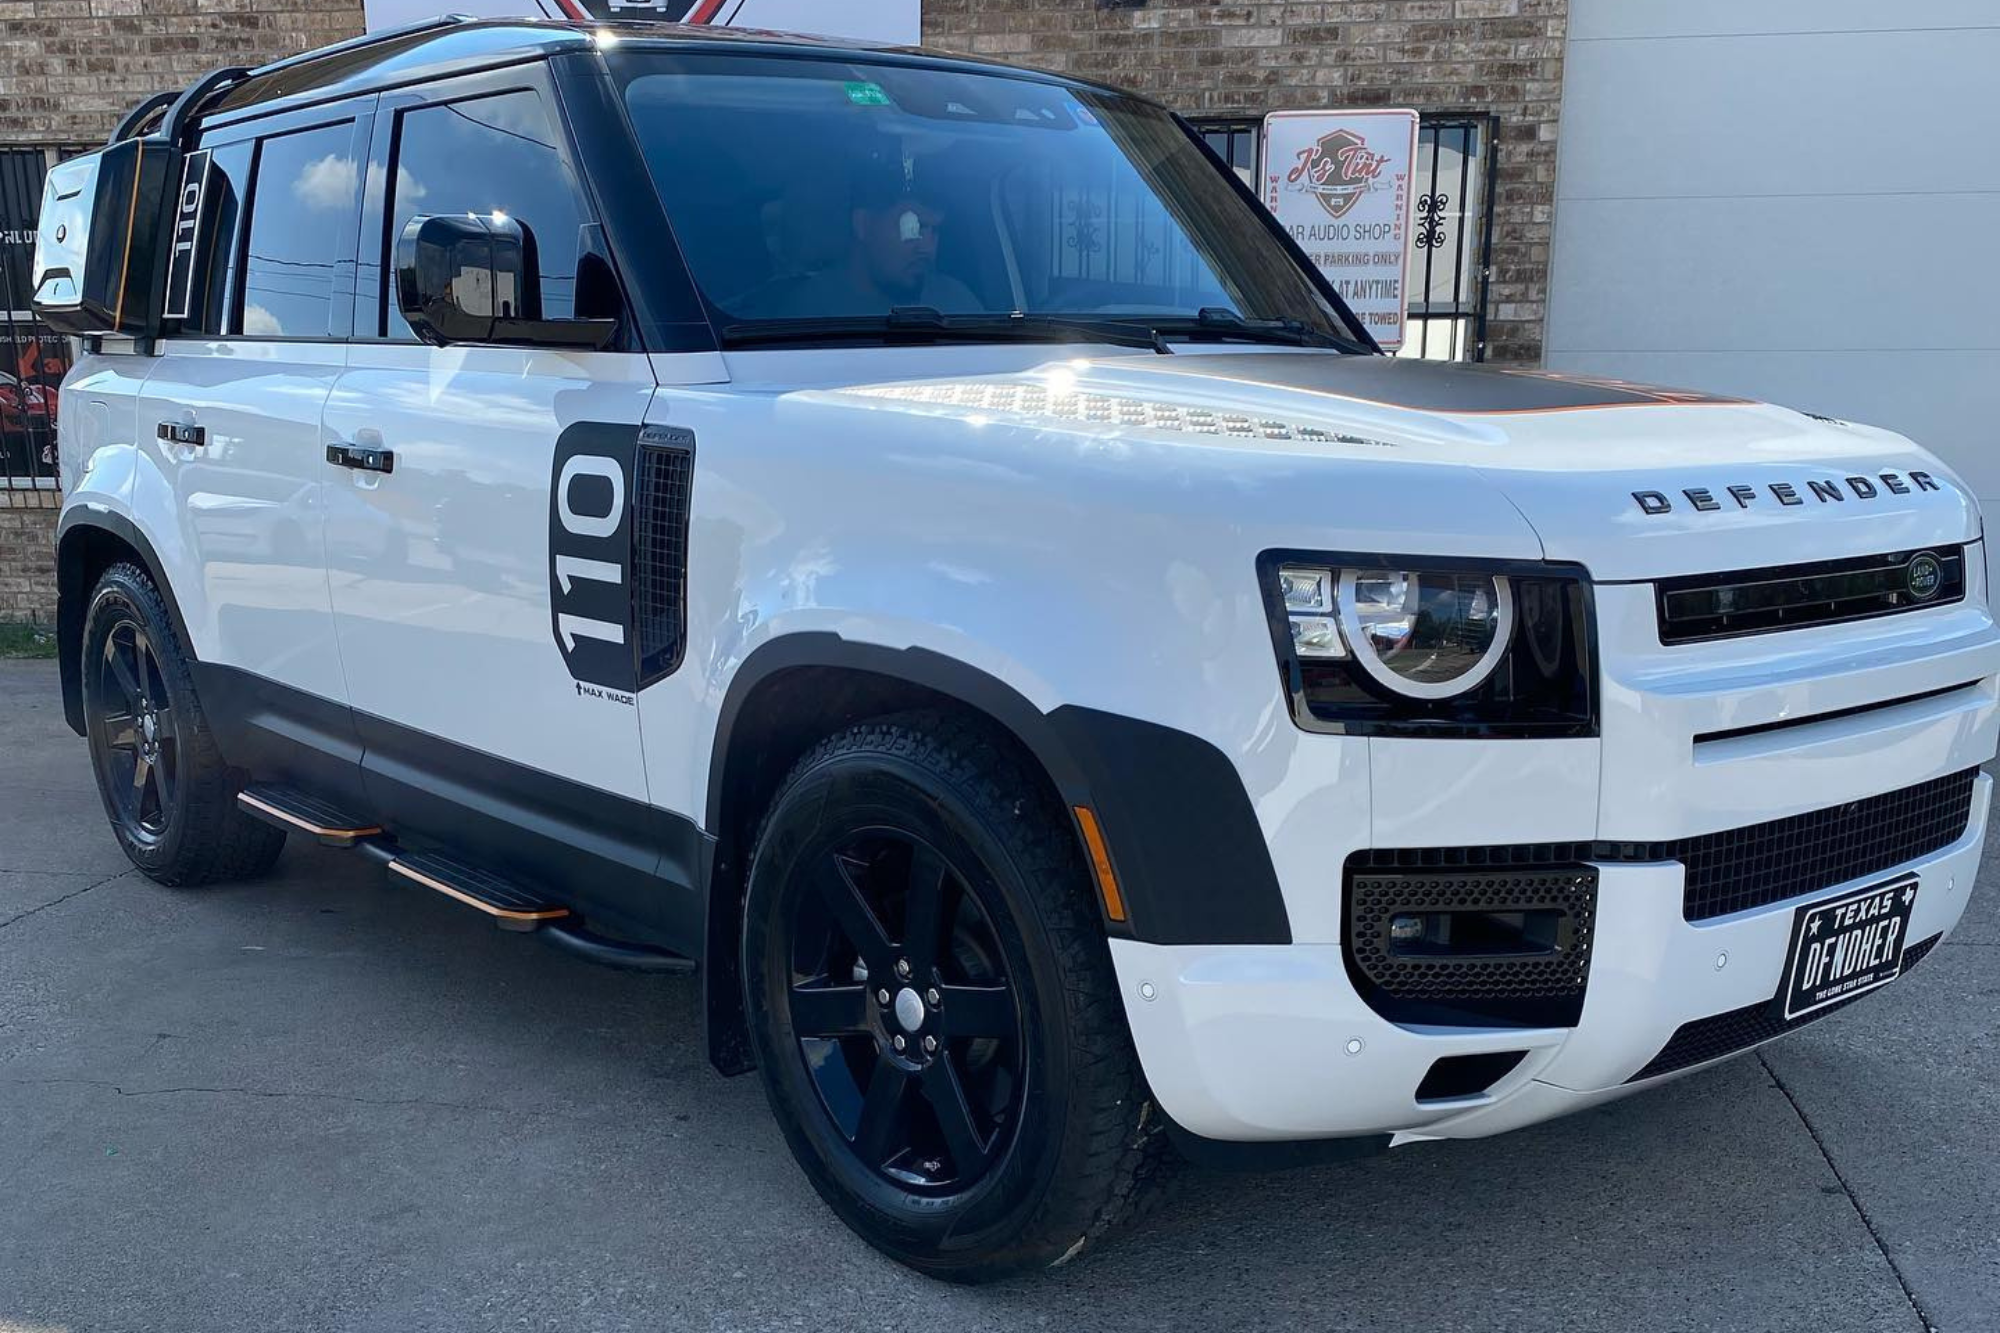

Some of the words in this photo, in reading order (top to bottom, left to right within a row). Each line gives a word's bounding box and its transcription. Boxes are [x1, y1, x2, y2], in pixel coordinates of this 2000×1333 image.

[1287, 147, 1335, 184] J's
[1338, 145, 1391, 181] Tint
[1269, 175, 1280, 213] WARN
[1393, 173, 1406, 240] WARNING
[176, 182, 200, 257] 110
[1284, 224, 1306, 240] AR
[1308, 223, 1350, 241] AUDIO
[1353, 223, 1391, 240] SHOP
[1323, 252, 1370, 266] PARKING
[1373, 252, 1400, 265] ONLY
[1352, 279, 1400, 299] ANYTIME
[1368, 312, 1400, 326] TOWED
[1631, 470, 1941, 516] DEFENDER
[557, 454, 625, 654] 110
[583, 685, 603, 699] MAX
[606, 691, 635, 706] WADE
[1834, 892, 1894, 929] TEXAS
[1802, 916, 1902, 991] DFNDHER
[1816, 989, 1827, 1001] THE
[1828, 983, 1842, 997] LONE
[1843, 978, 1857, 991] STAR
[1857, 972, 1875, 986] STATE
